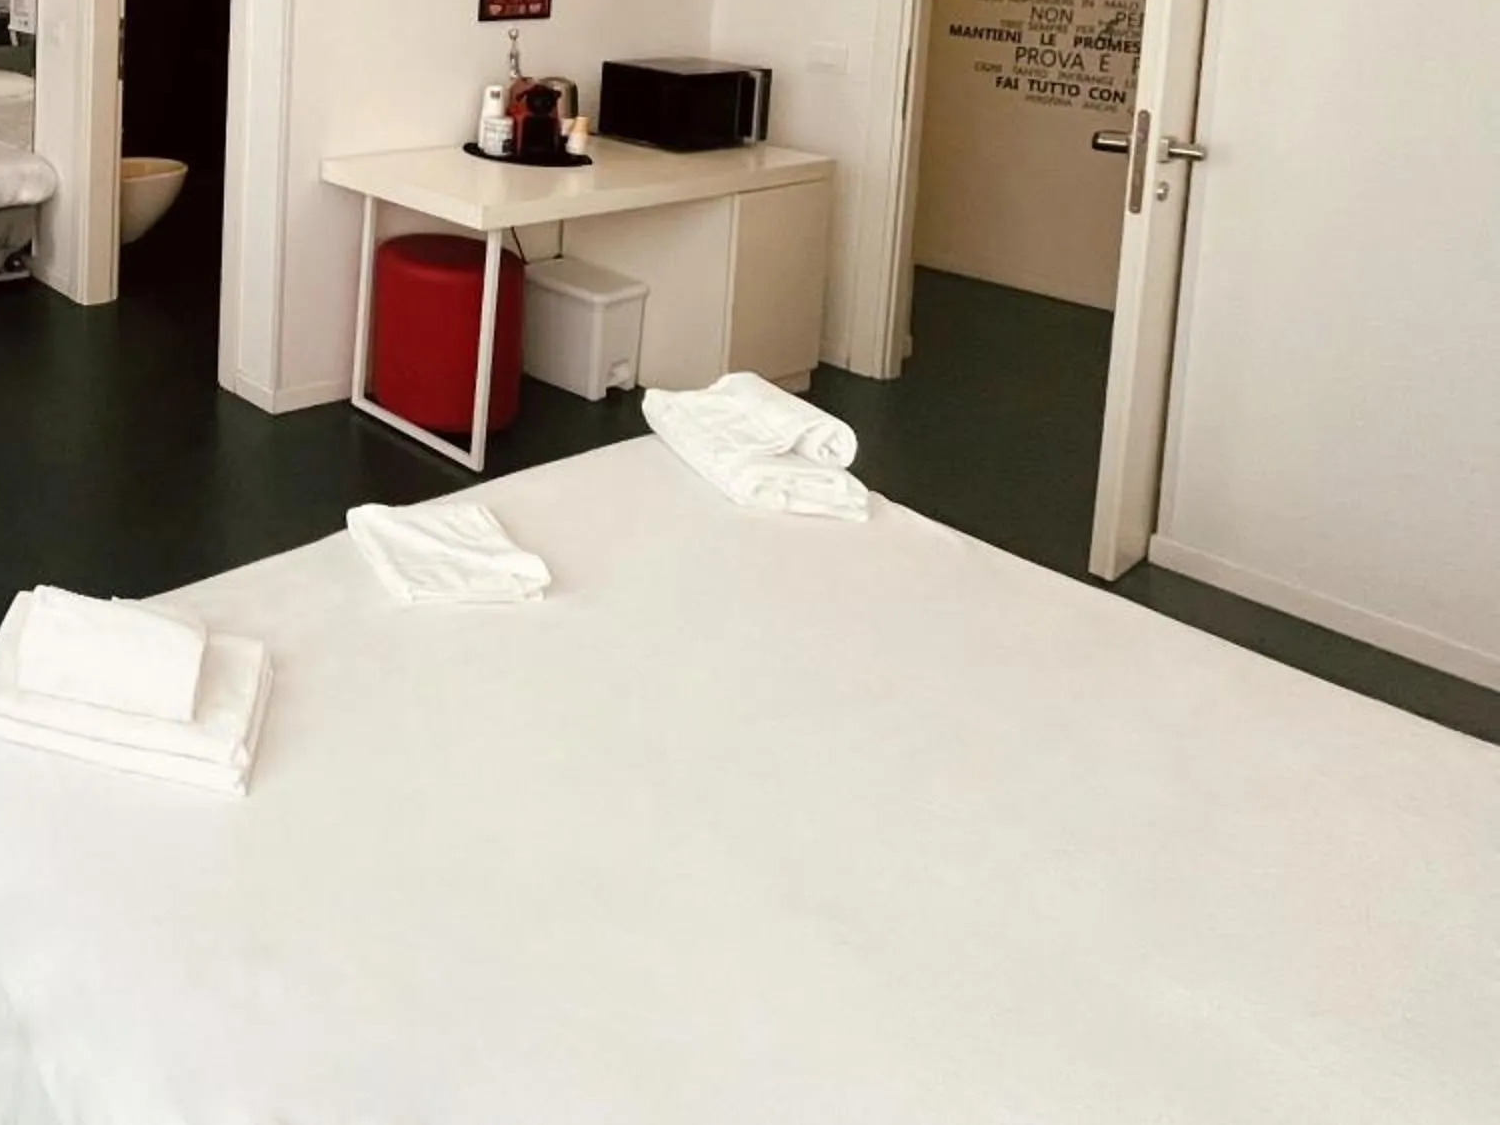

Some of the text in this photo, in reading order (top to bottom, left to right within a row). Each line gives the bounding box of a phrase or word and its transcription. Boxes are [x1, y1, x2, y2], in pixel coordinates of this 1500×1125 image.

[1030, 5, 1074, 24] NON
[949, 23, 1023, 44] MANTIENI
[1040, 33, 1056, 47] LE
[1073, 35, 1141, 54] PROMES
[1015, 46, 1085, 71] PROVA
[1099, 53, 1111, 73] E
[995, 76, 1019, 91] FAI
[1027, 78, 1081, 98] TUTTO
[1088, 86, 1127, 104] CON
